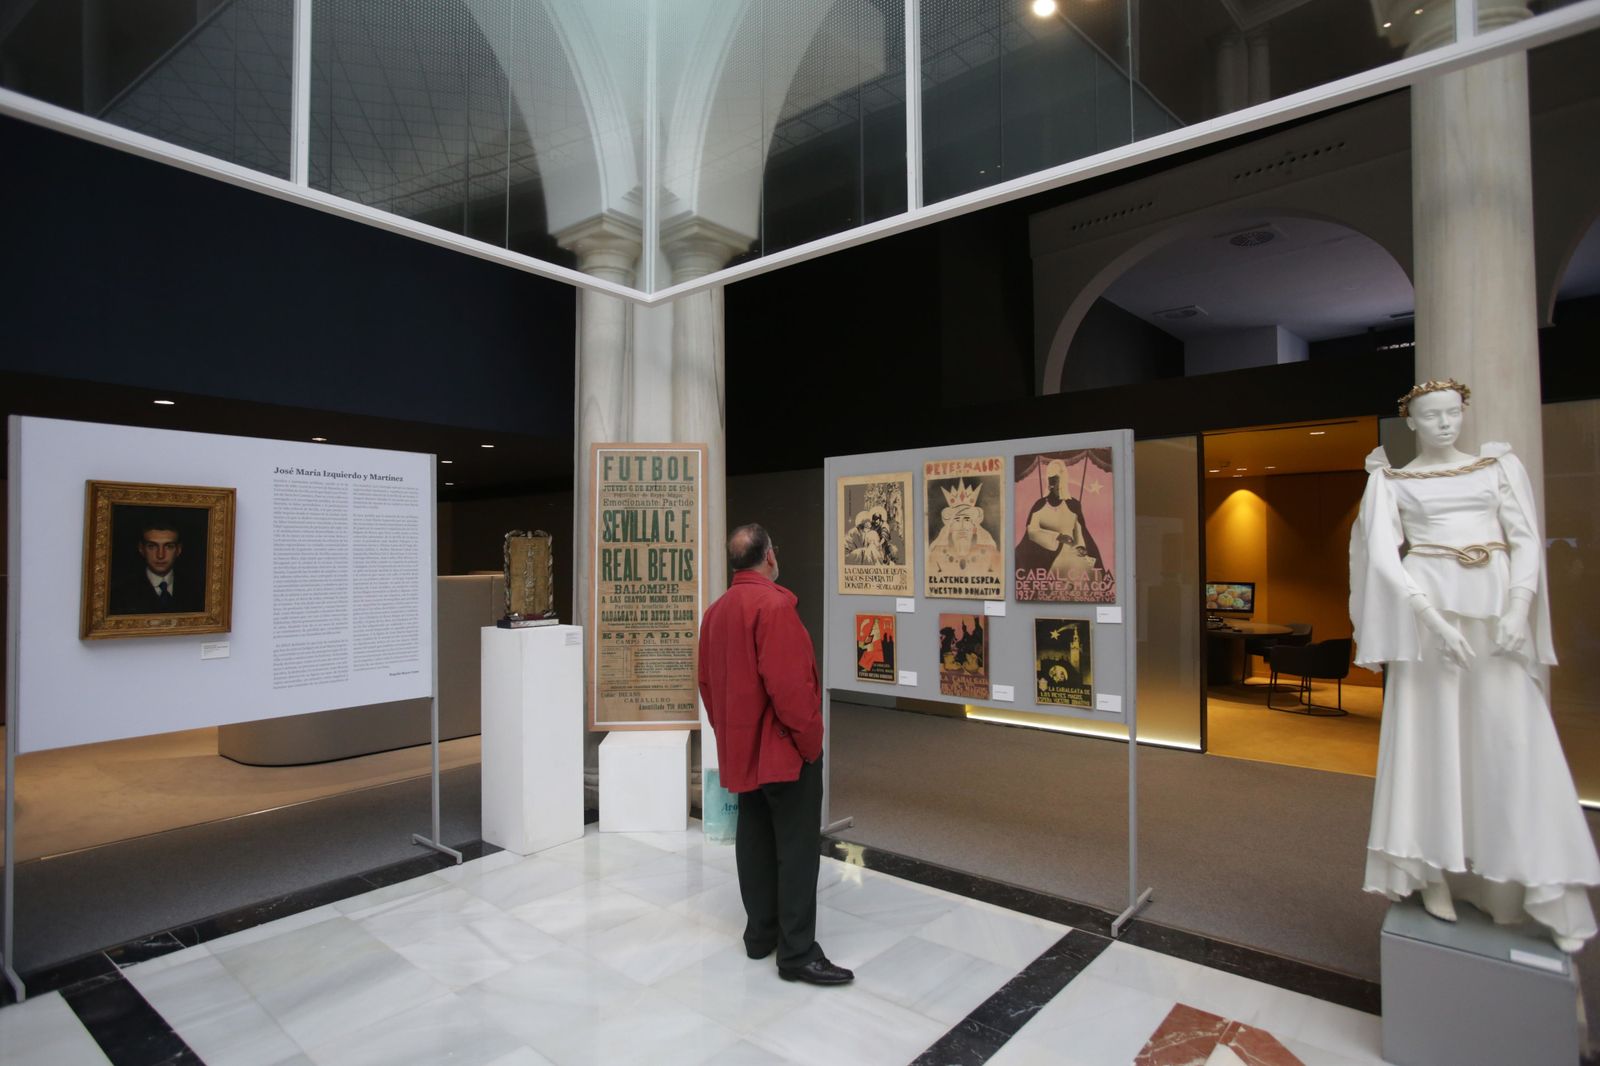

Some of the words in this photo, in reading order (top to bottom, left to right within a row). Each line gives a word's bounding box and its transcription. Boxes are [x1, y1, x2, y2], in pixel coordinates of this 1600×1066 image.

[604, 456, 694, 481] FUTBOL
[964, 458, 1000, 472] MAGOS
[296, 468, 321, 476] María
[323, 470, 362, 480] Izquierdo
[663, 498, 694, 506] Partido
[603, 510, 660, 542] SEVILLA
[602, 548, 642, 582] REAL
[648, 548, 694, 582] BETIS
[928, 576, 938, 584] EL
[970, 576, 1000, 584] ESPERA
[1016, 568, 1114, 581] CABALGATA
[614, 584, 679, 594] BALOMPIE
[929, 586, 962, 594] VUESTRO
[964, 588, 1000, 596] DONATIVO
[1016, 581, 1031, 590] DE
[1032, 581, 1068, 590] REYES
